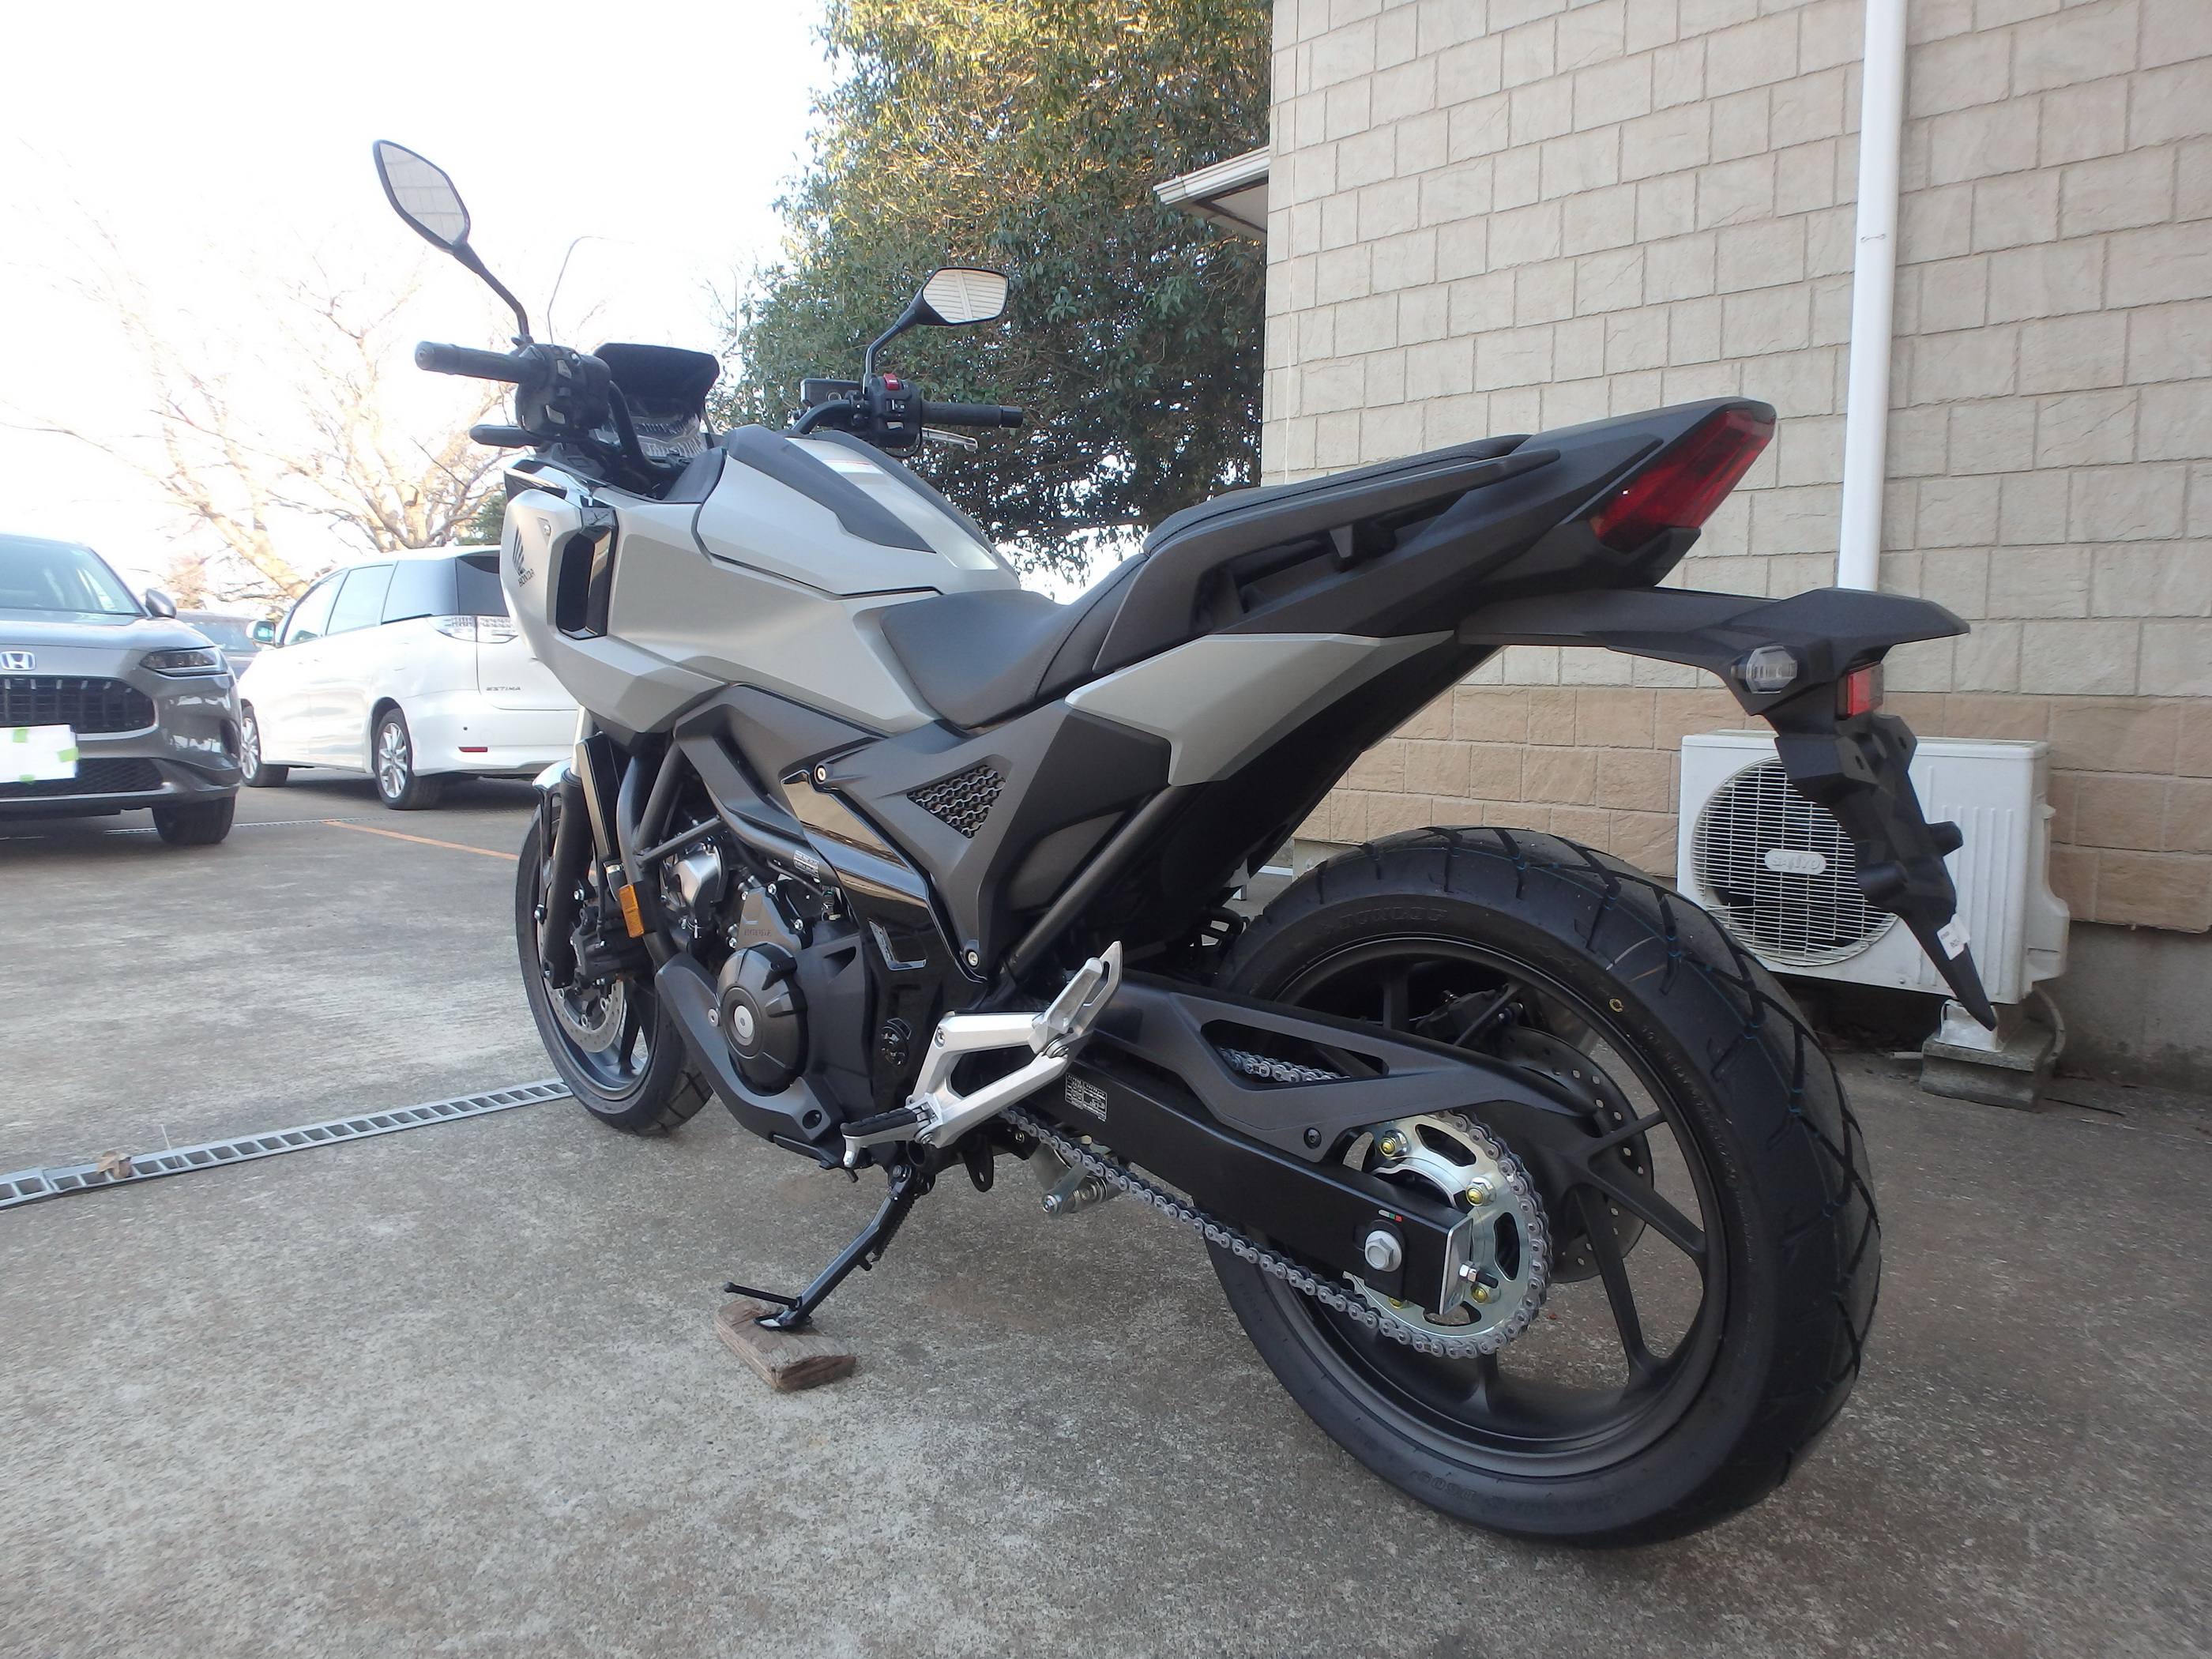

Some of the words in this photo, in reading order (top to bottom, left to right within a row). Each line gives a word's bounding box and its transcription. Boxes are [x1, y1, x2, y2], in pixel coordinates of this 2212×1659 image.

[517, 568, 536, 588] HONDA
[1771, 855, 1821, 870] SANYO
[1340, 907, 1448, 930] DUNLOP
[1417, 1470, 1477, 1501] D609
